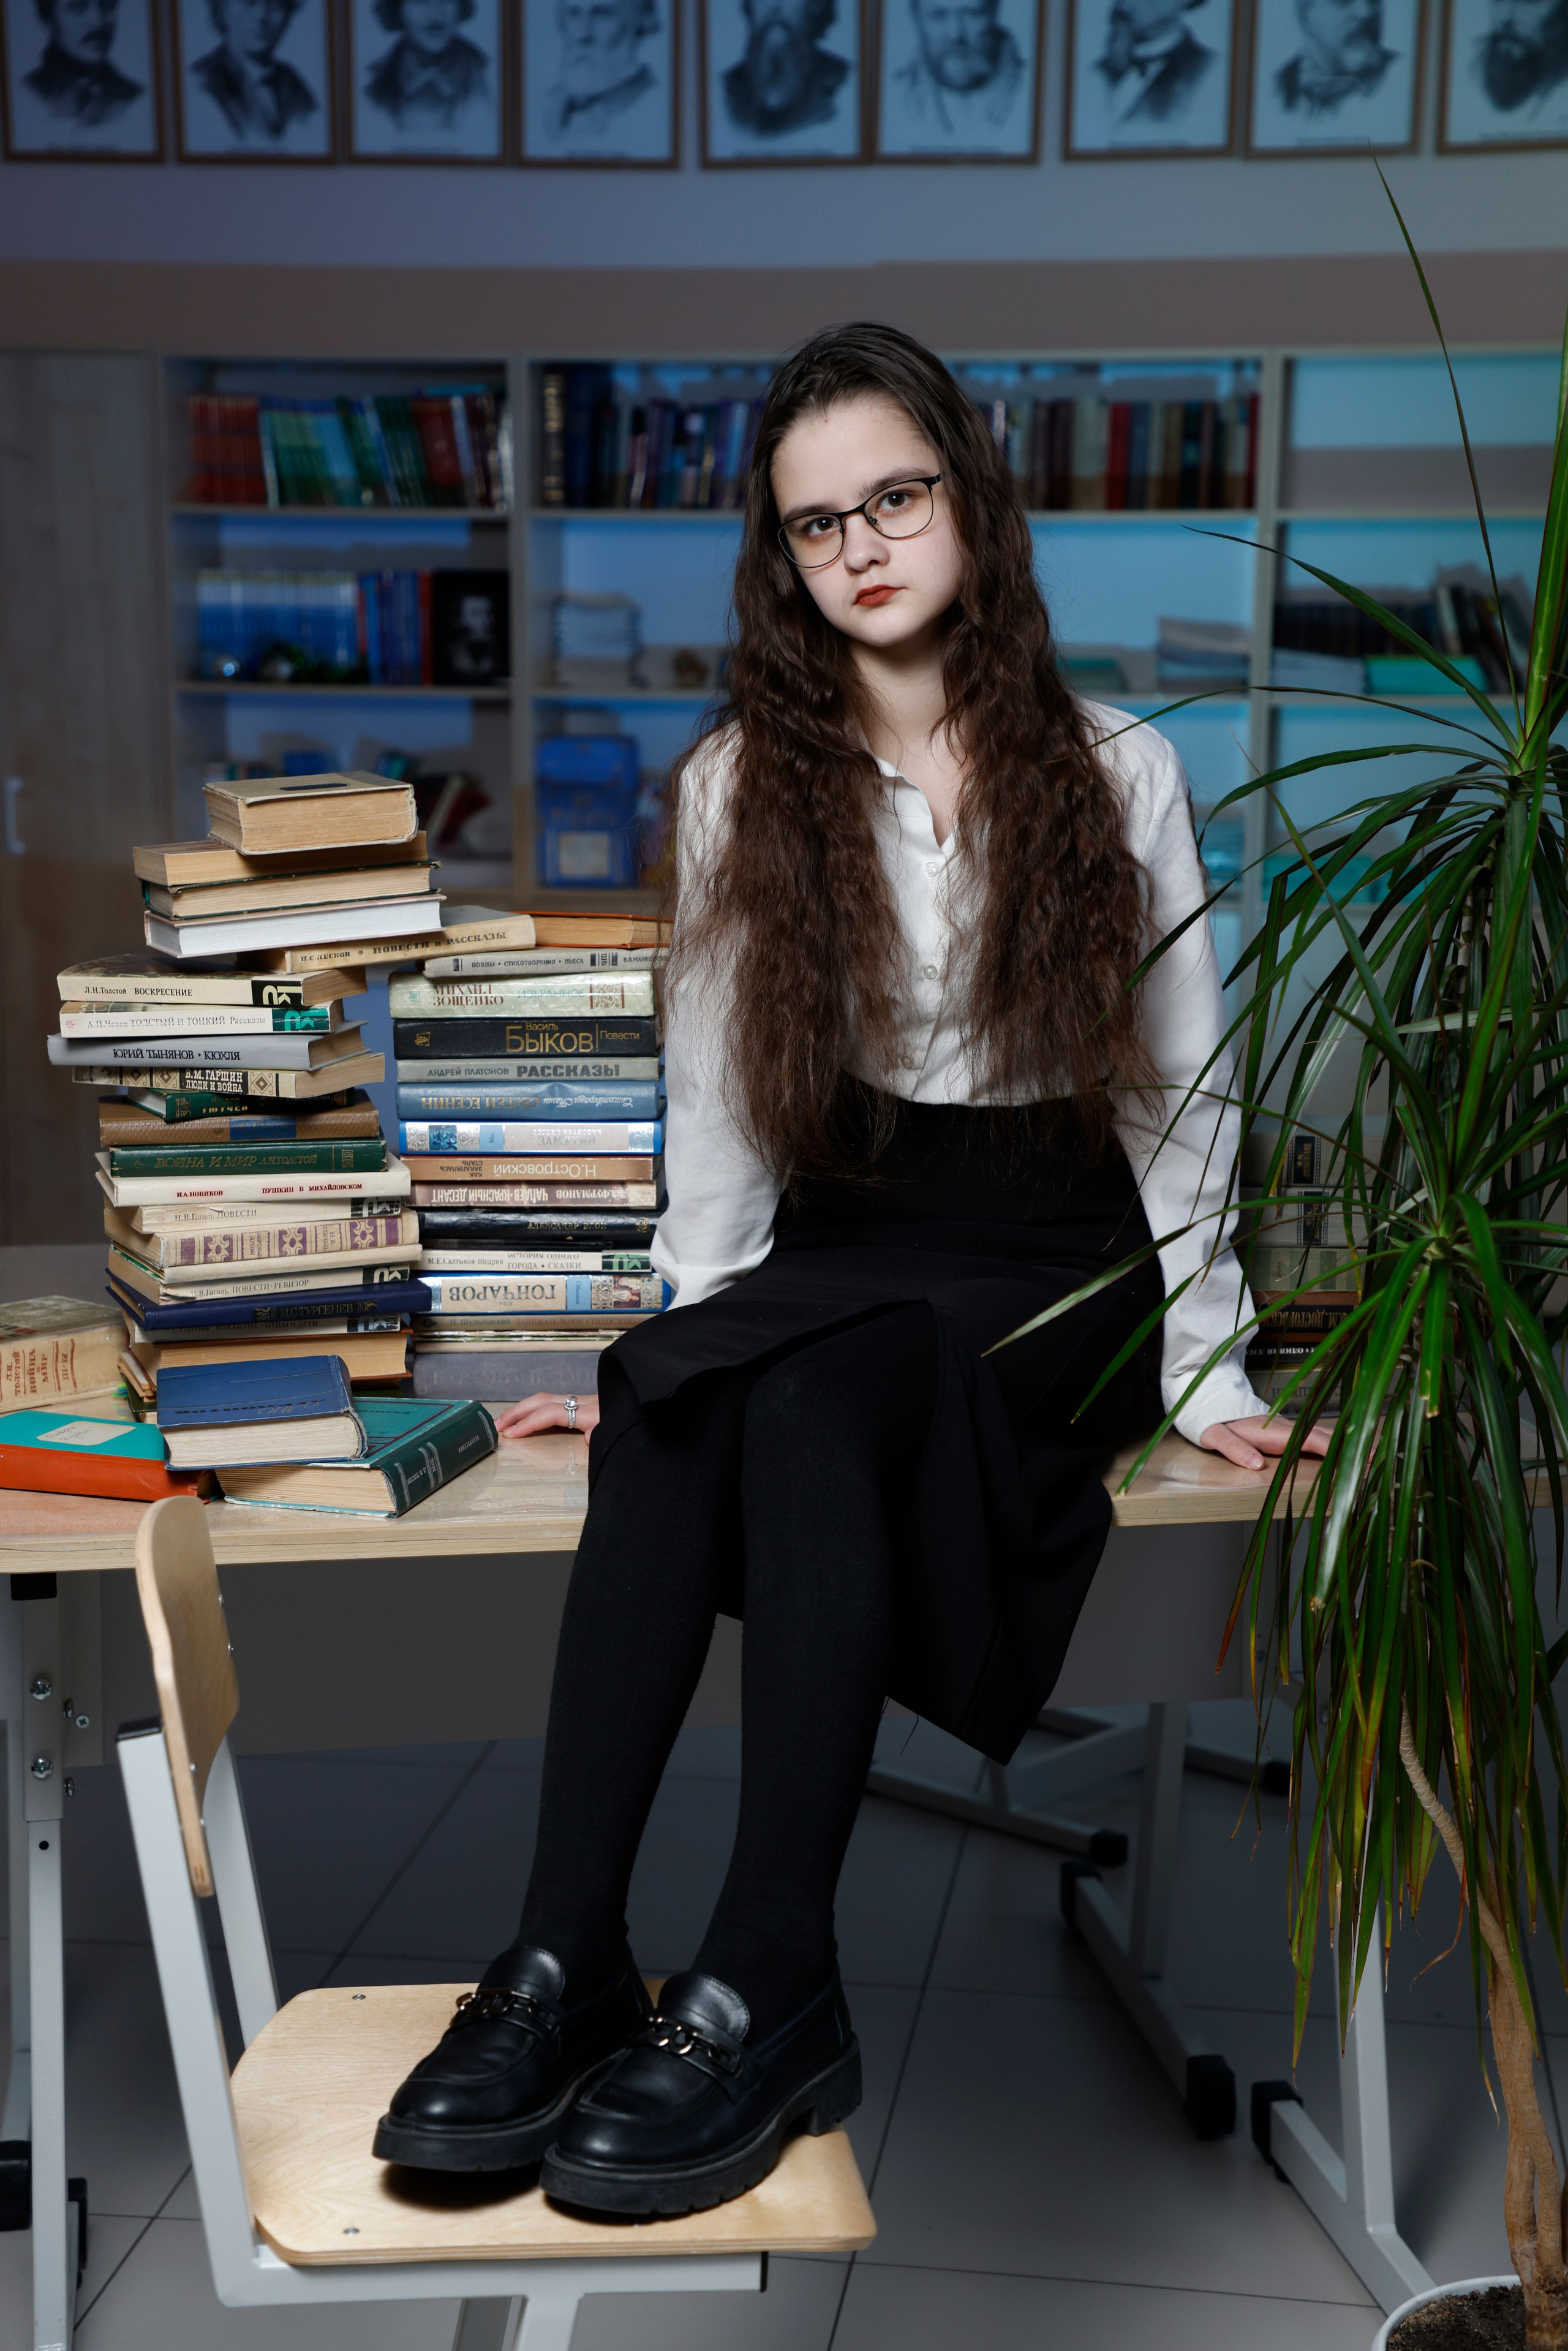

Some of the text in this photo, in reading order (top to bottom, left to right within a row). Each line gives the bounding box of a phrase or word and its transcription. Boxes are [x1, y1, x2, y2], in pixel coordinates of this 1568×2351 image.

[372, 942, 429, 954] ПОВЕСТИ
[447, 932, 507, 945] РАССКАЗЫ
[503, 959, 556, 967] СТИХОТВОРЕНИЯ
[134, 987, 193, 997] ВОСКРЕСЕНИЕ
[433, 984, 504, 1008] МИХАИЛ ЗОЩЕНКО
[517, 988, 584, 999] ИЗБРАННОЕ
[130, 1016, 175, 1028] ТОЛСТЫЙ
[178, 1017, 184, 1026] И
[186, 1015, 226, 1026] ТОНКИЙ
[230, 1015, 265, 1025] Рассказы
[526, 1021, 559, 1032] Василь
[599, 1030, 640, 1041] Повести
[113, 1048, 241, 1061] ЮРИЙ ТЫНЯНОВ КЮХЛЯ
[185, 1070, 243, 1083] В.М. ГАРШИН
[428, 1064, 620, 1078] АНДРЕЙ ПЛАТОНОВ РАССКАЗЫ
[186, 1079, 243, 1093] ЛЮДИ И ВОЙНА
[421, 1096, 539, 1110] СЕРГЕЙ ЕСЕНИН
[154, 1156, 205, 1169] ВОЙНА
[209, 1157, 222, 1168] И
[224, 1155, 257, 1168] МИР
[494, 1161, 596, 1177] Н.Островский
[309, 1183, 363, 1191] МИХАЙЛОВСКОМ
[431, 1188, 468, 1203] ДЕСАНТ
[469, 1188, 510, 1205] КРАСНЫЙ
[513, 1188, 549, 1204] ЧАПАЕВ
[217, 1208, 257, 1220] ПОВЕСТИ
[507, 1262, 537, 1270] ГОРОДА
[232, 1282, 270, 1294] ПОВЕСТИ
[274, 1279, 309, 1290] РЕВИЗОР
[450, 1283, 557, 1302] ГОНЧАРОВ
[461, 1318, 511, 1327] Шульговский
[12, 1351, 21, 1396] ТОЛСТОЙ
[26, 1348, 37, 1394] ВОЙНА
[40, 1353, 49, 1384] МИР
